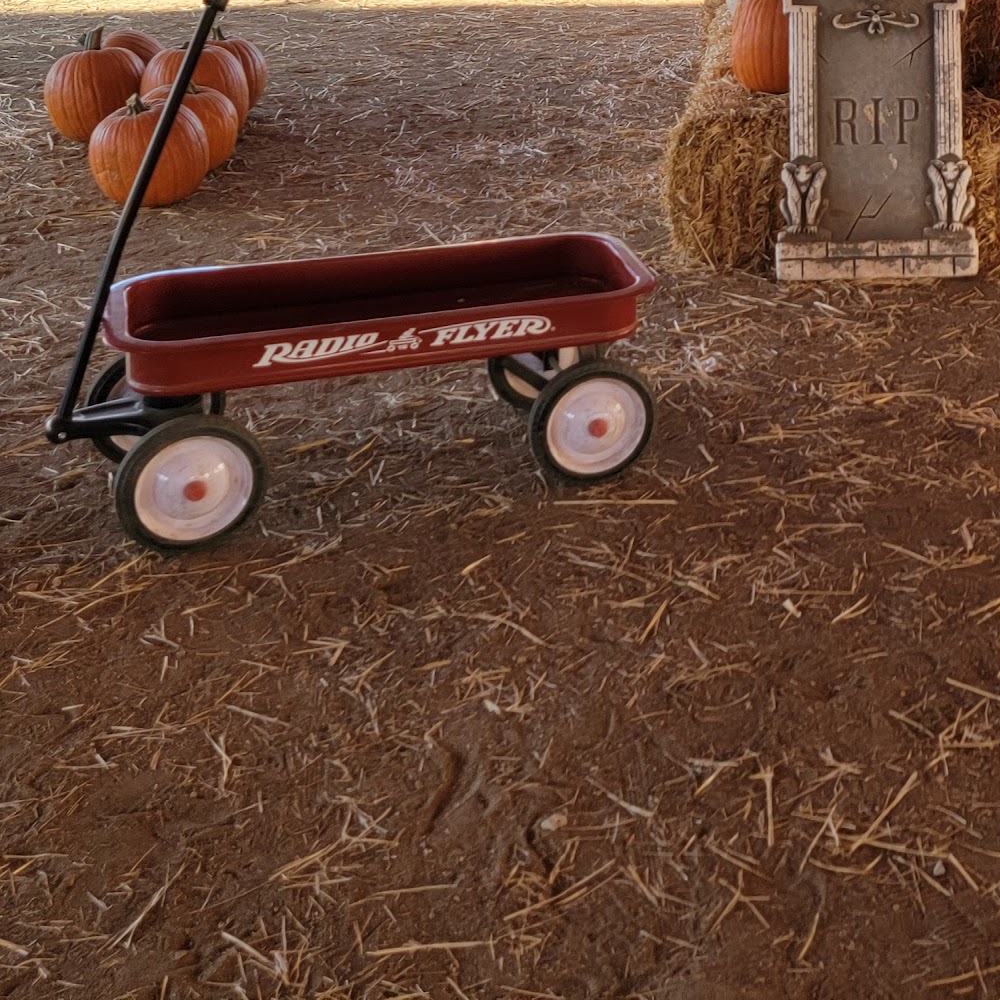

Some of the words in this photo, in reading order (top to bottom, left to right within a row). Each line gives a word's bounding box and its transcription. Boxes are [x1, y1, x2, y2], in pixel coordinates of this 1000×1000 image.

[832, 96, 919, 146] RIP
[252, 331, 381, 368] RADIO
[429, 315, 552, 347] FLYER
